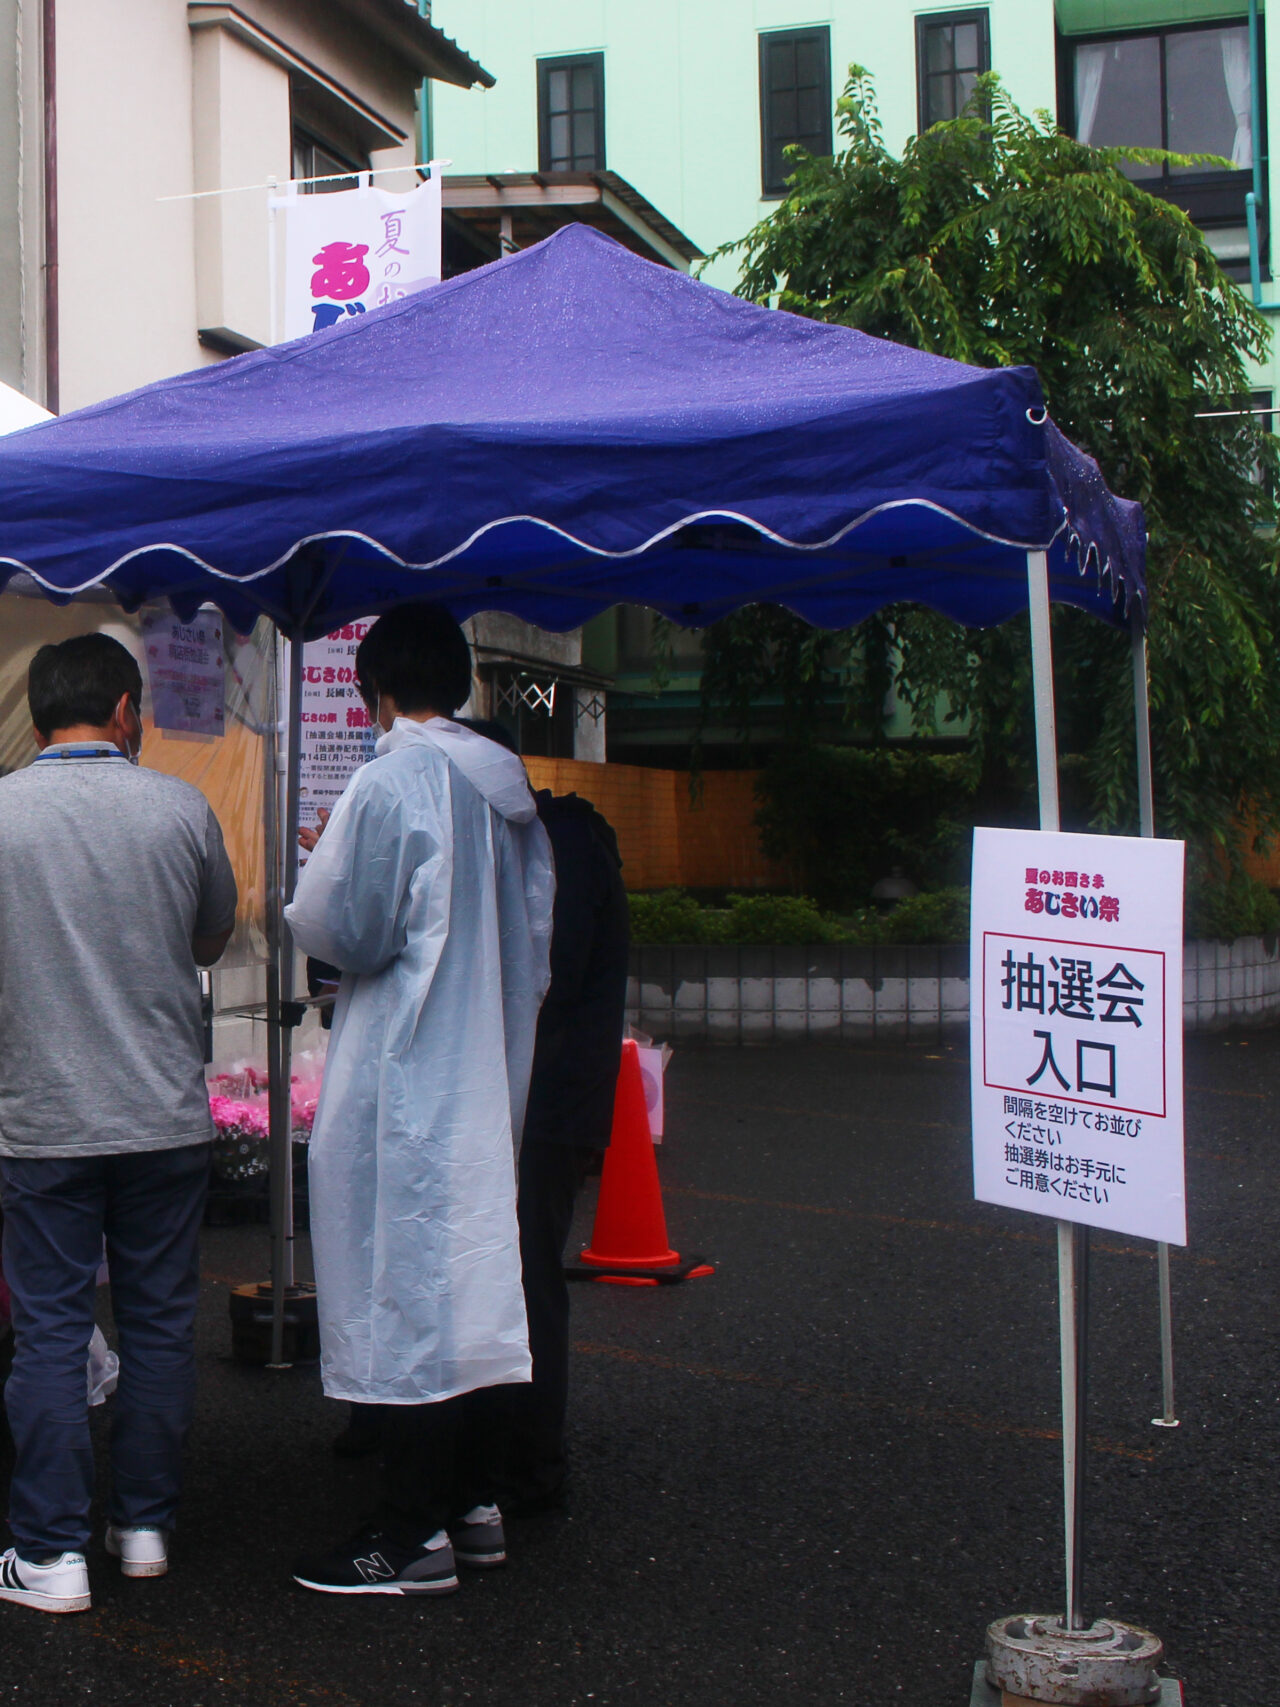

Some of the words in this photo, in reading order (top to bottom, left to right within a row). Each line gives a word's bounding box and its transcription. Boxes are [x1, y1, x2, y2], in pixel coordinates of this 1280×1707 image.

[1024, 867, 1105, 890] 夏のお酉さま
[1024, 887, 1120, 922] あじさい祭
[1001, 949, 1145, 1029] 抽選会
[1026, 1029, 1118, 1099] 入口
[1003, 1095, 1142, 1138] 間隔を空けてお並び
[1004, 1120, 1062, 1146] ください
[1004, 1142, 1127, 1185] 抽選券はお手元に
[1005, 1167, 1109, 1204] ご用意ください
